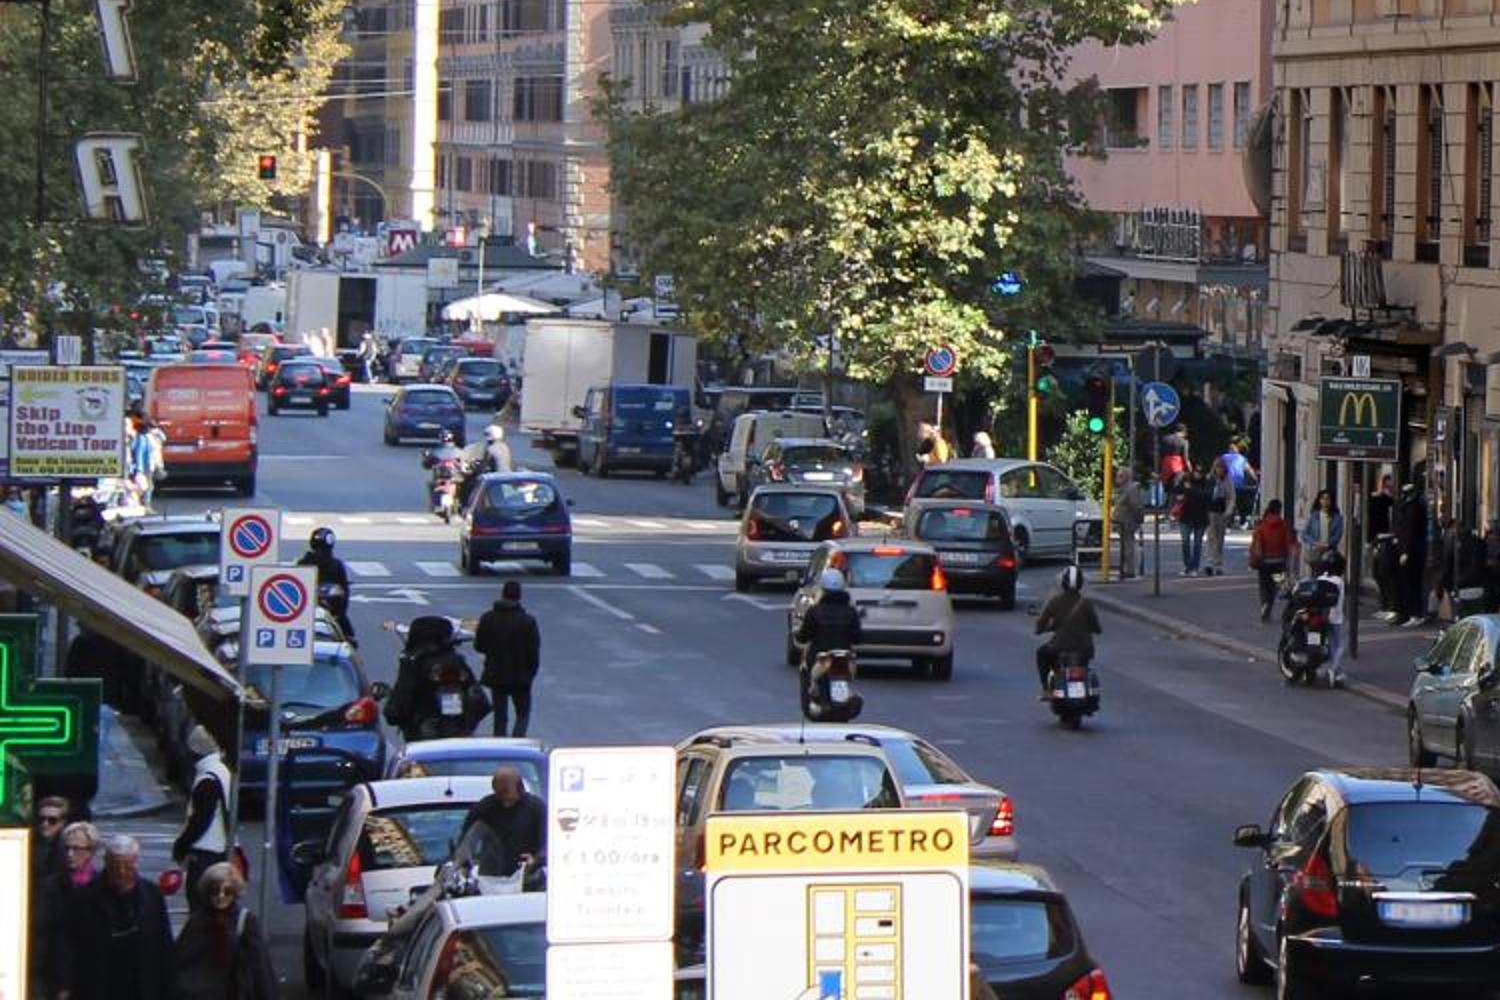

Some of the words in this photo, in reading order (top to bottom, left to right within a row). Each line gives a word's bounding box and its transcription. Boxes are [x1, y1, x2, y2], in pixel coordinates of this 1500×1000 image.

[16, 406, 61, 421] Skip
[81, 437, 118, 451] Tour
[719, 828, 954, 857] PARCOMETRO
